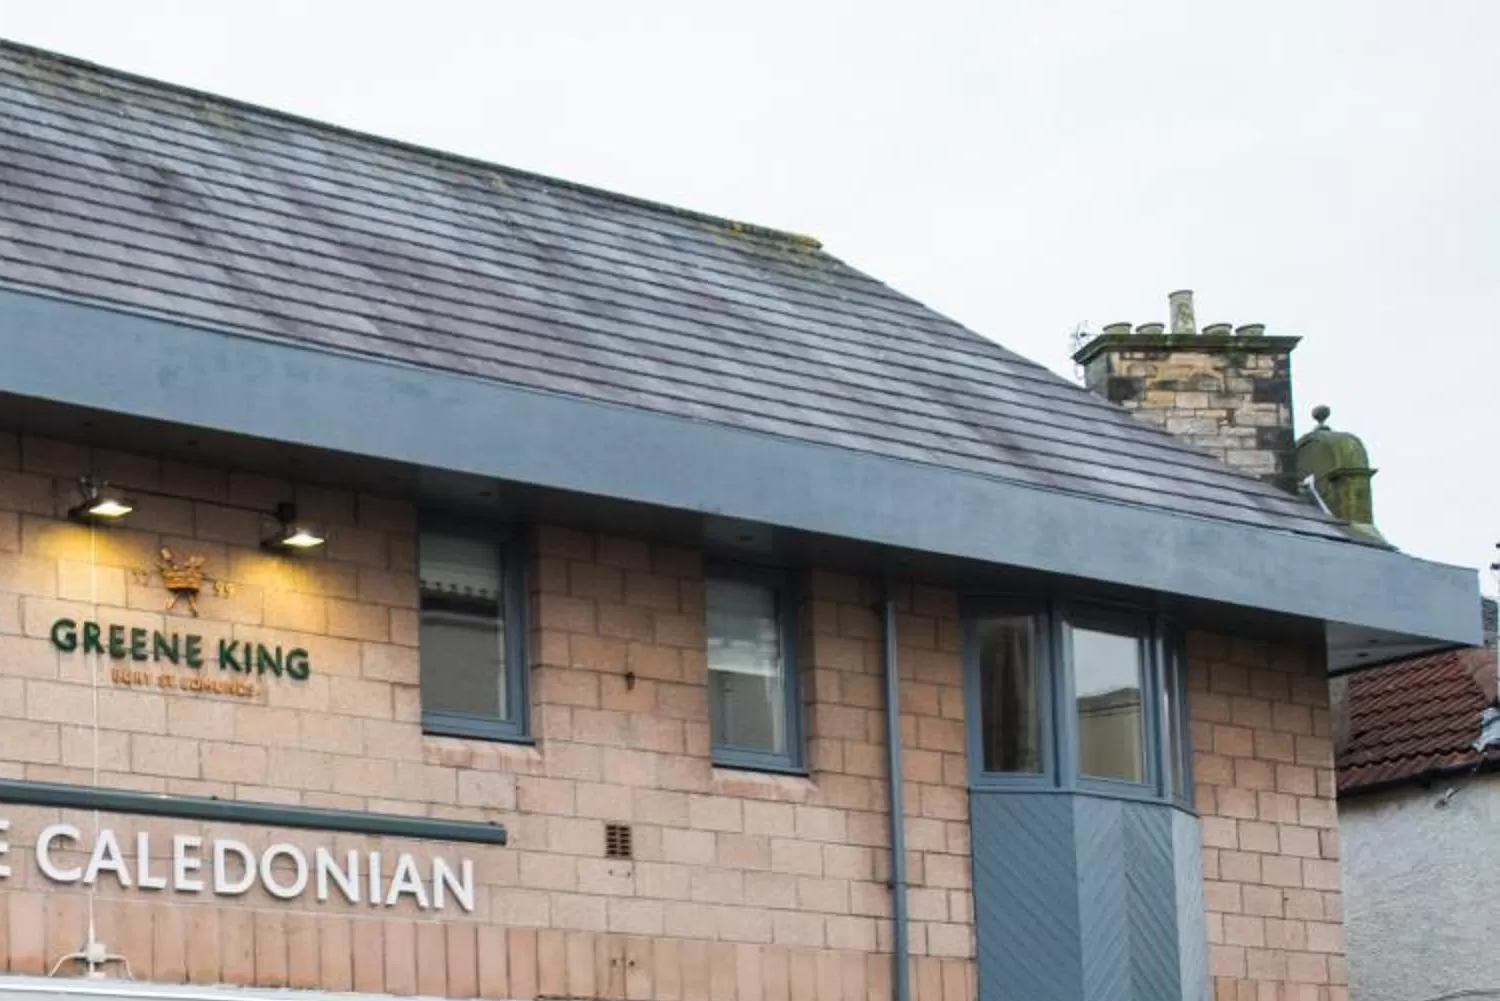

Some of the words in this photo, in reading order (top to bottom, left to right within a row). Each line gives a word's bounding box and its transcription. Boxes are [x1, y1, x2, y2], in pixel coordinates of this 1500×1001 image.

[50, 618, 204, 669] GREENE
[219, 638, 311, 681] KING
[35, 822, 476, 912] CALEDONIAN
